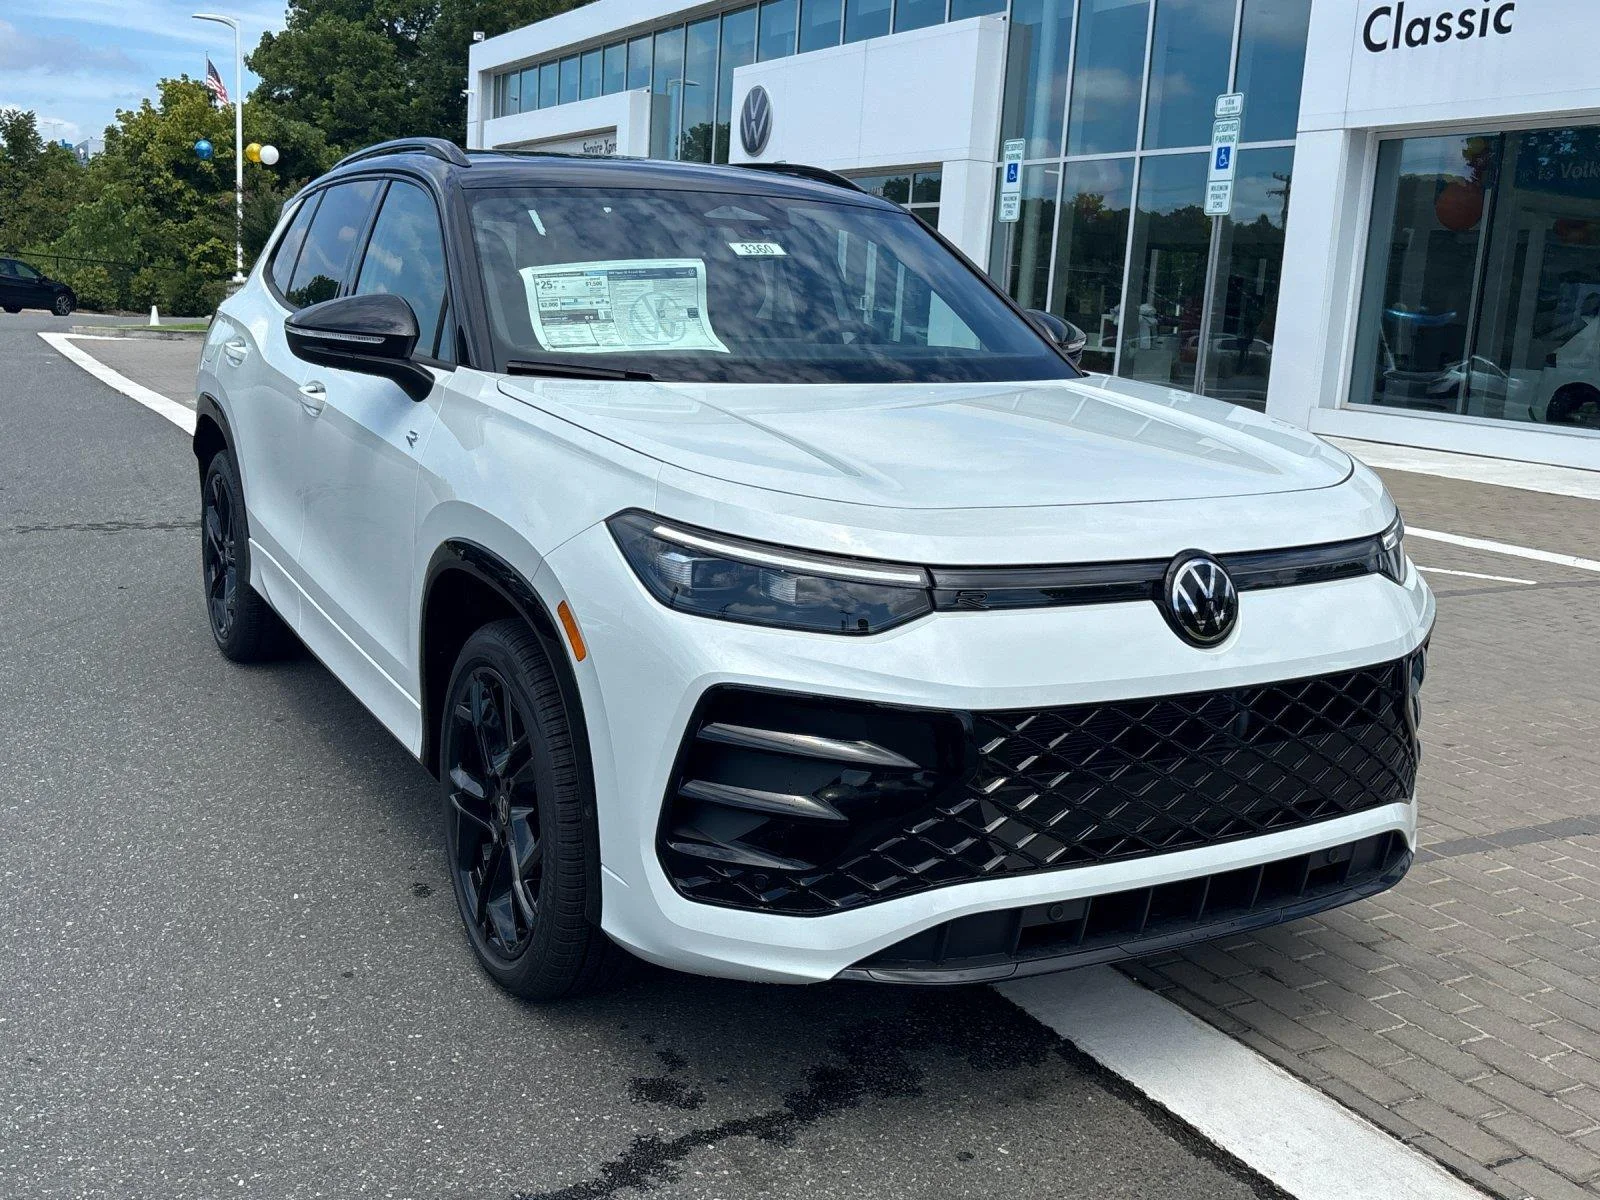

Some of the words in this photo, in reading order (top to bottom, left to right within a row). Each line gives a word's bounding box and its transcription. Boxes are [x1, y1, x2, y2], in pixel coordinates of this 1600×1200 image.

[1363, 0, 1515, 52] Classic
[1215, 123, 1238, 133] RESERVED
[1216, 134, 1235, 143] PARKING
[741, 244, 775, 254] 3360
[540, 280, 553, 290] 25
